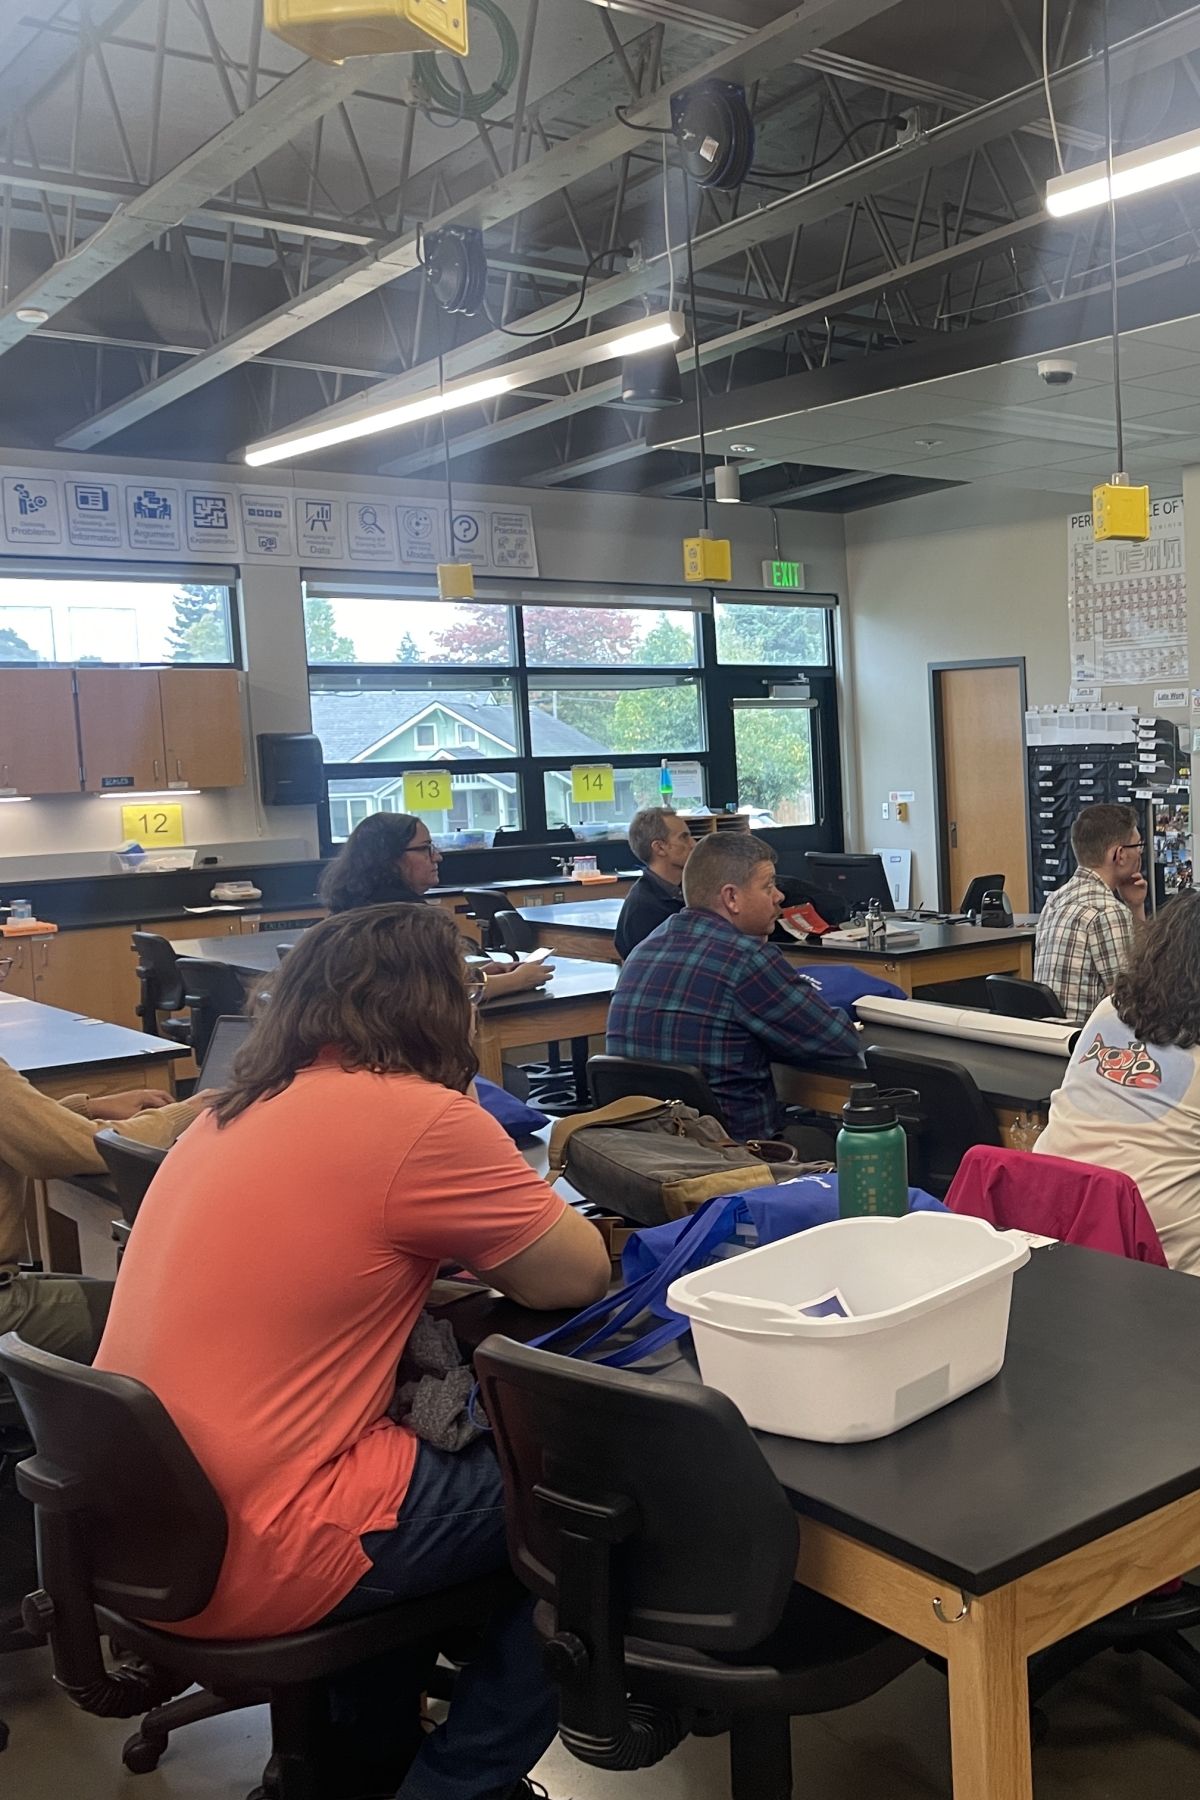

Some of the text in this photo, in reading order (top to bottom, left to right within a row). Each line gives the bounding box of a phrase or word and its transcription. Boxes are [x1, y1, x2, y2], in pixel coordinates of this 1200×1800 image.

[1163, 500, 1179, 515] OF
[11, 526, 57, 537] Problems
[71, 532, 120, 543] Information
[133, 530, 175, 539] Argument
[310, 545, 332, 555] Data
[772, 561, 800, 588] EXIT
[1170, 692, 1185, 700] Work
[582, 773, 603, 791] 14
[416, 780, 440, 799] 13
[138, 813, 169, 834] 12
